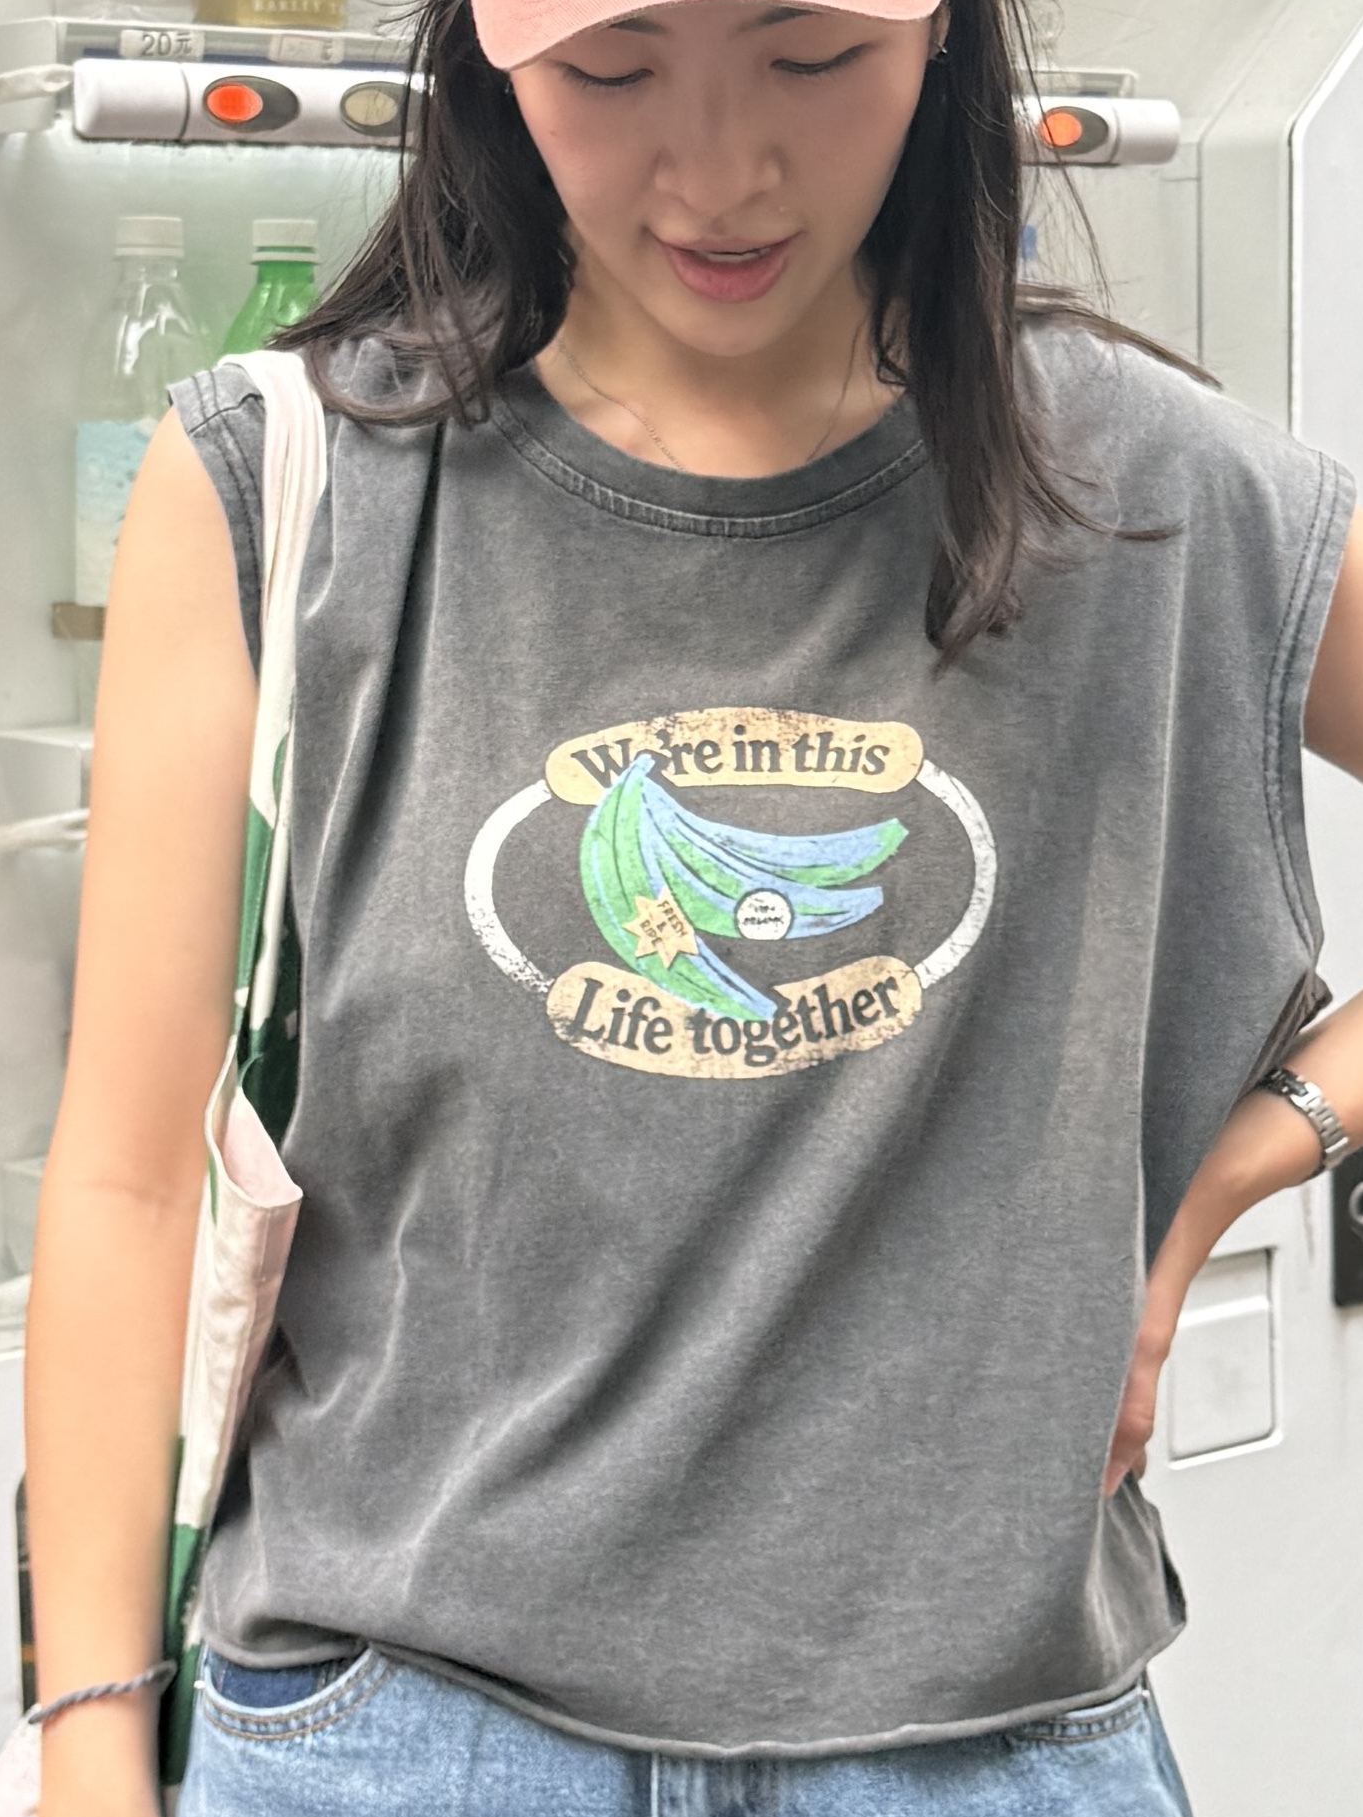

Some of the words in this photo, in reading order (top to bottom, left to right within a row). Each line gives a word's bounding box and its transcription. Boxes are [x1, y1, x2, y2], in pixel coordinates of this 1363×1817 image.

[732, 724, 783, 773] in
[792, 731, 889, 776] this
[658, 900, 688, 936] FRESH
[571, 977, 673, 1055] Life
[686, 975, 900, 1068] together
